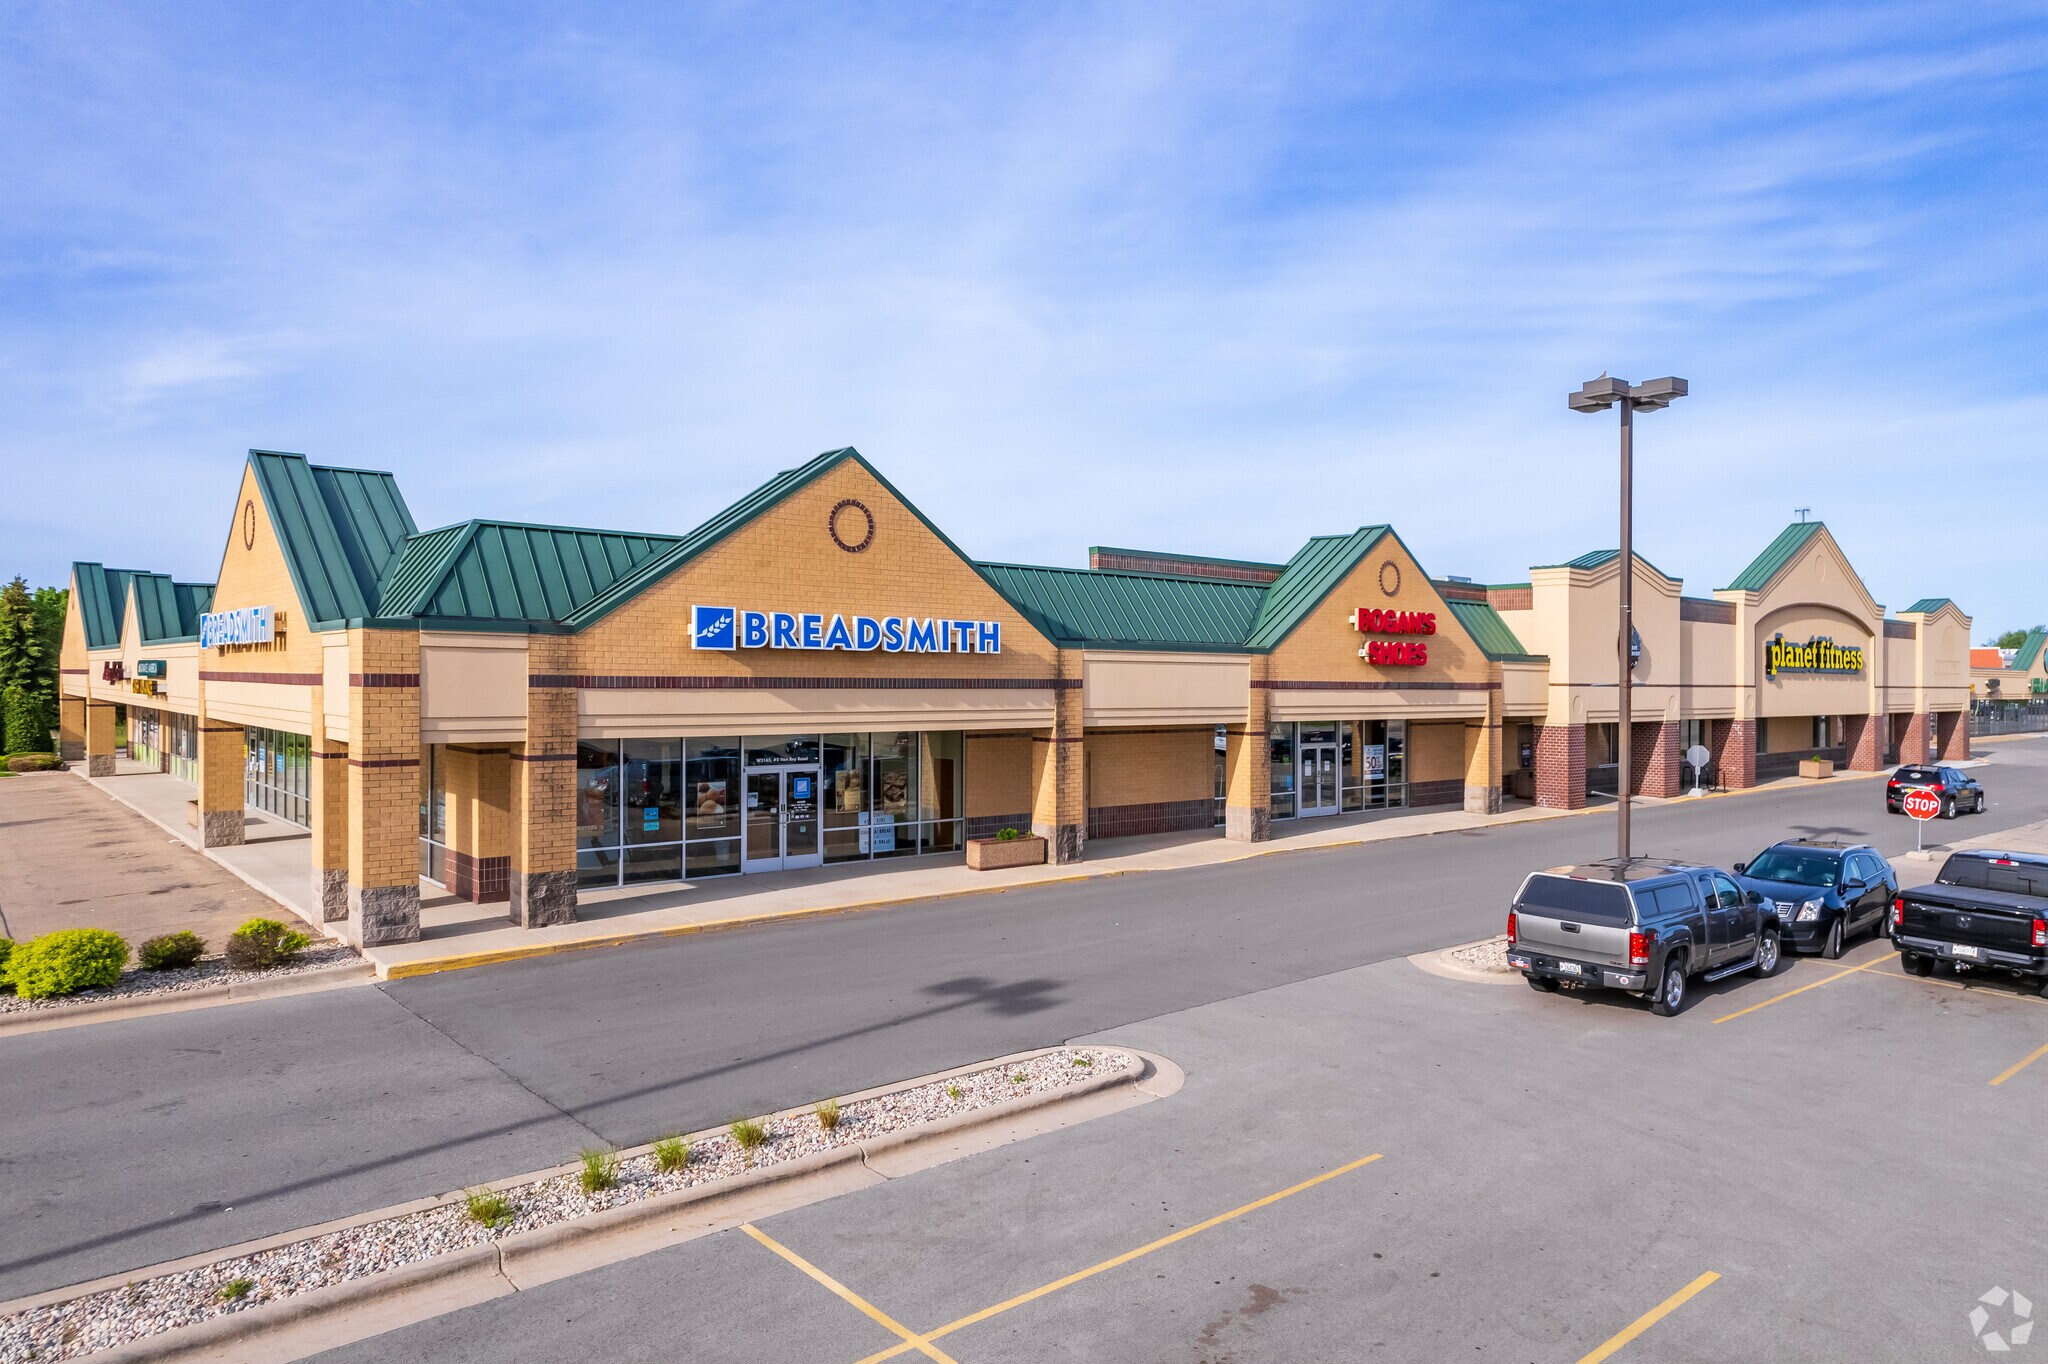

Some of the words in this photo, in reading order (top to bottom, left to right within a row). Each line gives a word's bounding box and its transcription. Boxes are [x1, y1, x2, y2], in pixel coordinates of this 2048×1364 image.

[208, 607, 267, 646] BREADSMITH
[740, 610, 1000, 654] BREADSMITH
[1355, 608, 1436, 635] ROGAN'S
[1364, 641, 1428, 667] SHOES
[1771, 638, 1818, 675] planet
[1820, 641, 1864, 669] fitness
[1906, 796, 1938, 812] STOP
